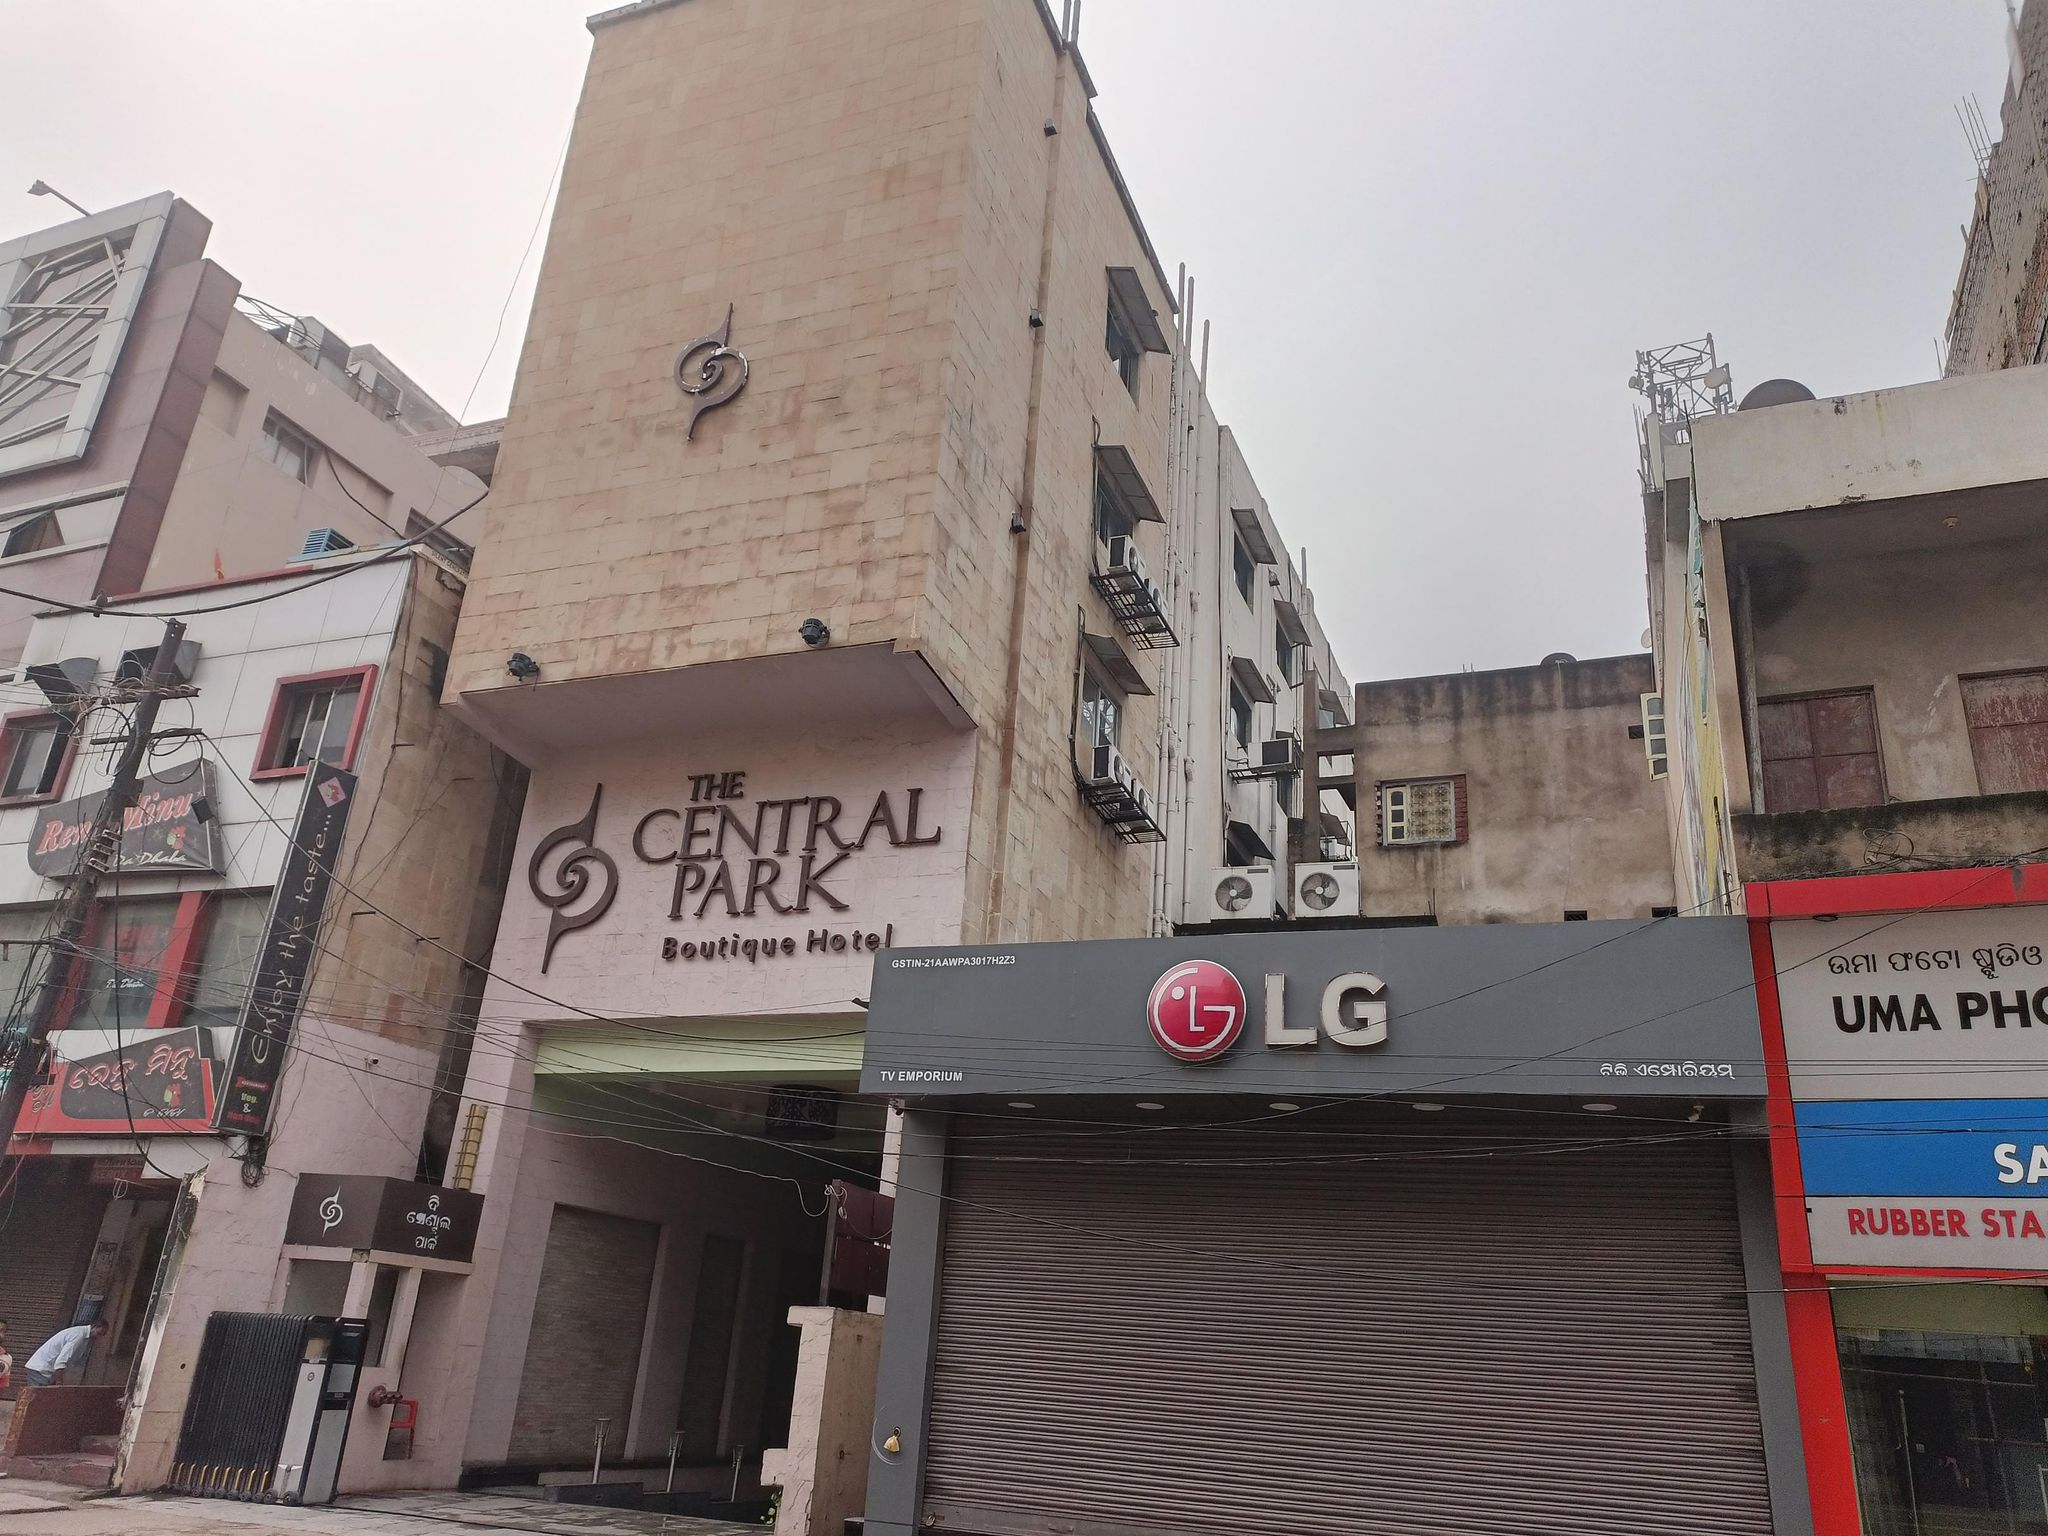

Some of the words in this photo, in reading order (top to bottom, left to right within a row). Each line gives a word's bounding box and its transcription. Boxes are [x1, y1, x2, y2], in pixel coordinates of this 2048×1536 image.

[687, 771, 746, 801] THE
[632, 787, 942, 864] CENTRAL
[666, 851, 851, 919] PARK
[661, 932, 797, 964] Boutique
[806, 923, 894, 953] Hotel
[1827, 953, 1878, 975] ଉମା
[252, 969, 293, 1064] Enjoy
[278, 914, 304, 960] the
[1263, 971, 1388, 1047] LG
[1831, 993, 1942, 1034] UMA
[880, 1071, 896, 1082] TV
[897, 1070, 963, 1082] EMPORIUM
[242, 1103, 252, 1113] &
[1847, 1207, 1970, 1238] RUBBER
